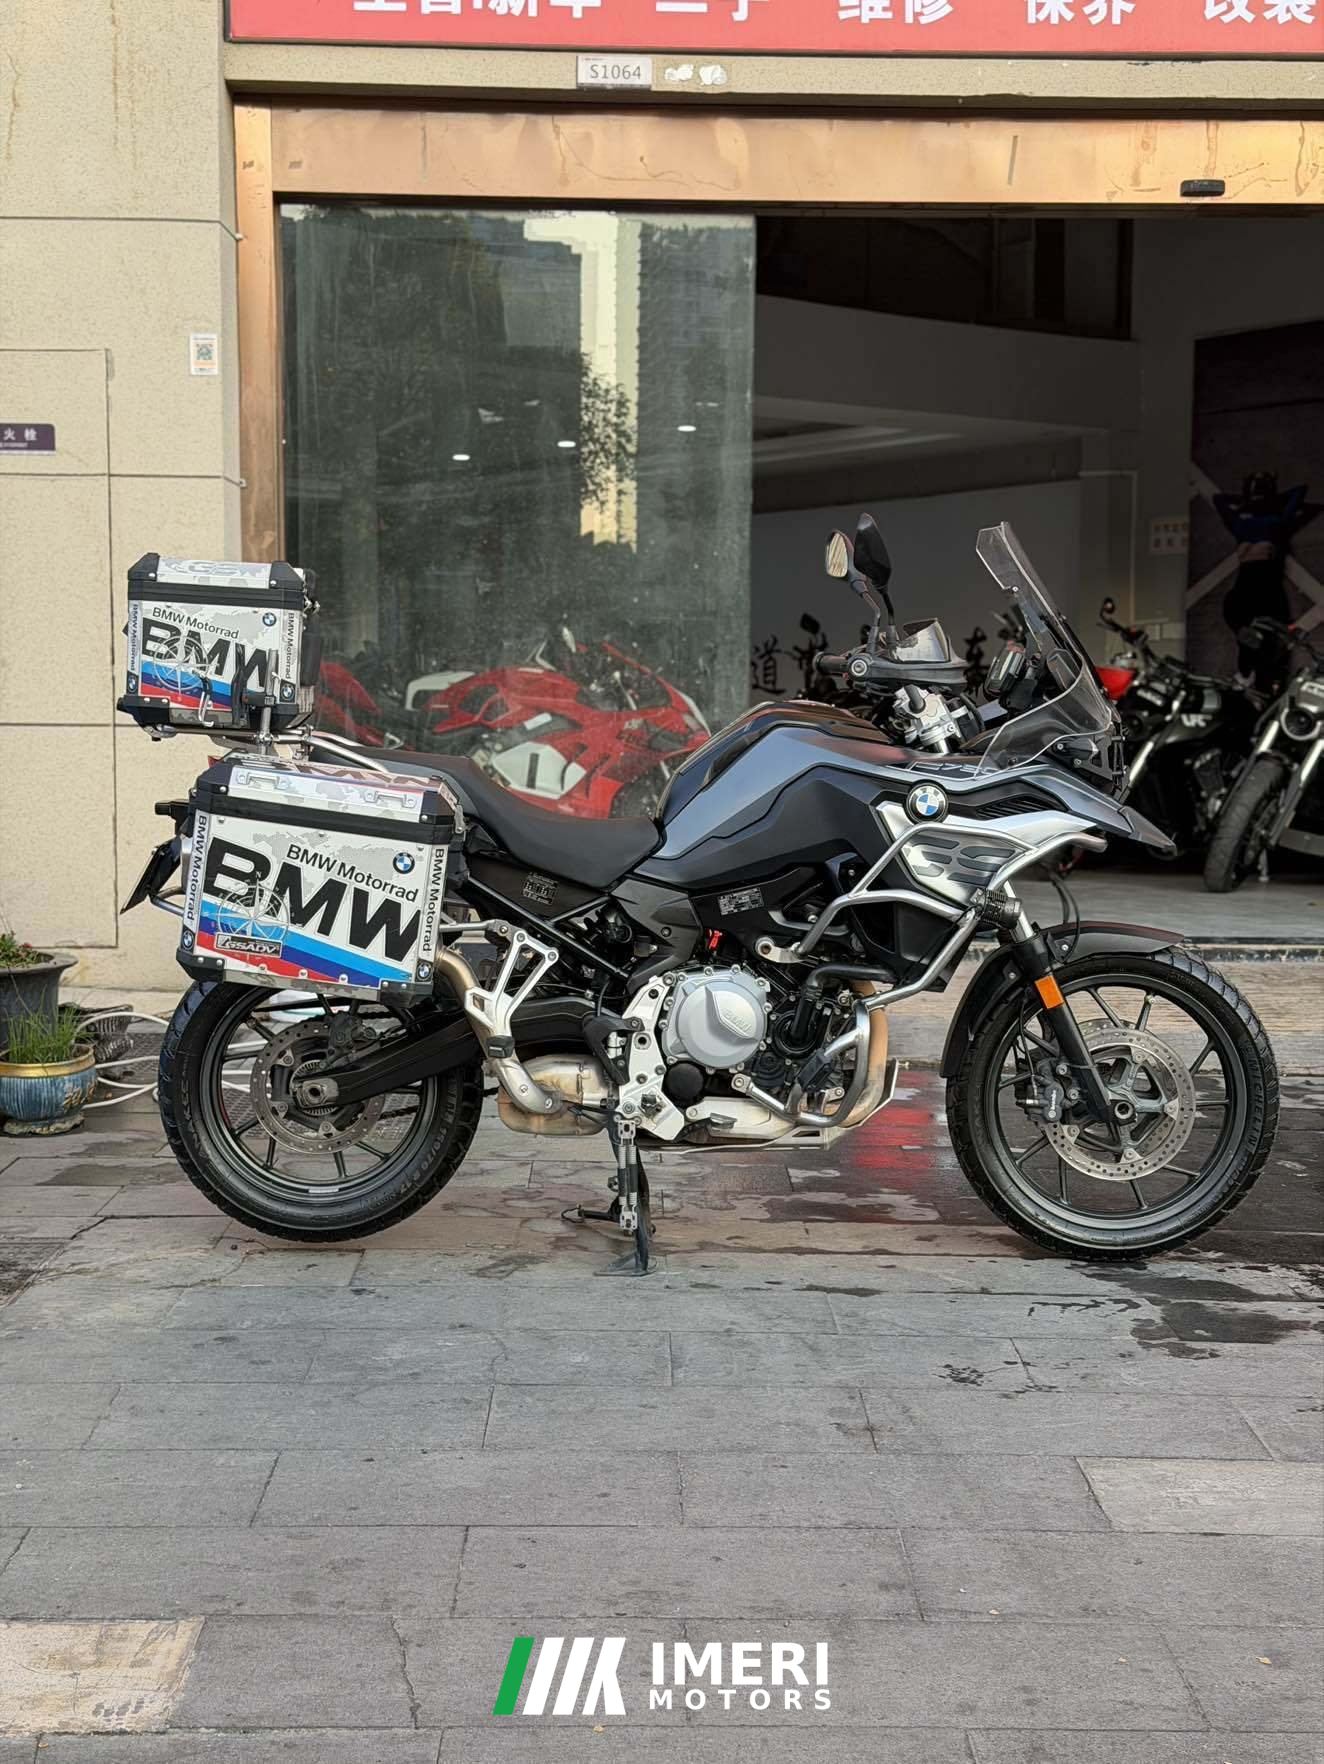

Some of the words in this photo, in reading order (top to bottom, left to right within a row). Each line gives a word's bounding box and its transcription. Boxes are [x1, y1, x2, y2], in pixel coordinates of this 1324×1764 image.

[590, 64, 641, 80] S1064
[152, 606, 184, 625] BMW
[186, 616, 239, 640] Motorrad
[287, 612, 295, 639] BMW
[142, 617, 270, 693] BMW
[285, 639, 294, 680] Motorrad
[195, 815, 207, 854] BMW
[186, 854, 205, 921] Motorrad
[286, 844, 337, 874] BMW
[337, 864, 419, 903] Motorrad
[432, 848, 445, 886] BMW
[202, 837, 422, 962] BMW
[422, 888, 440, 952] Motorrad
